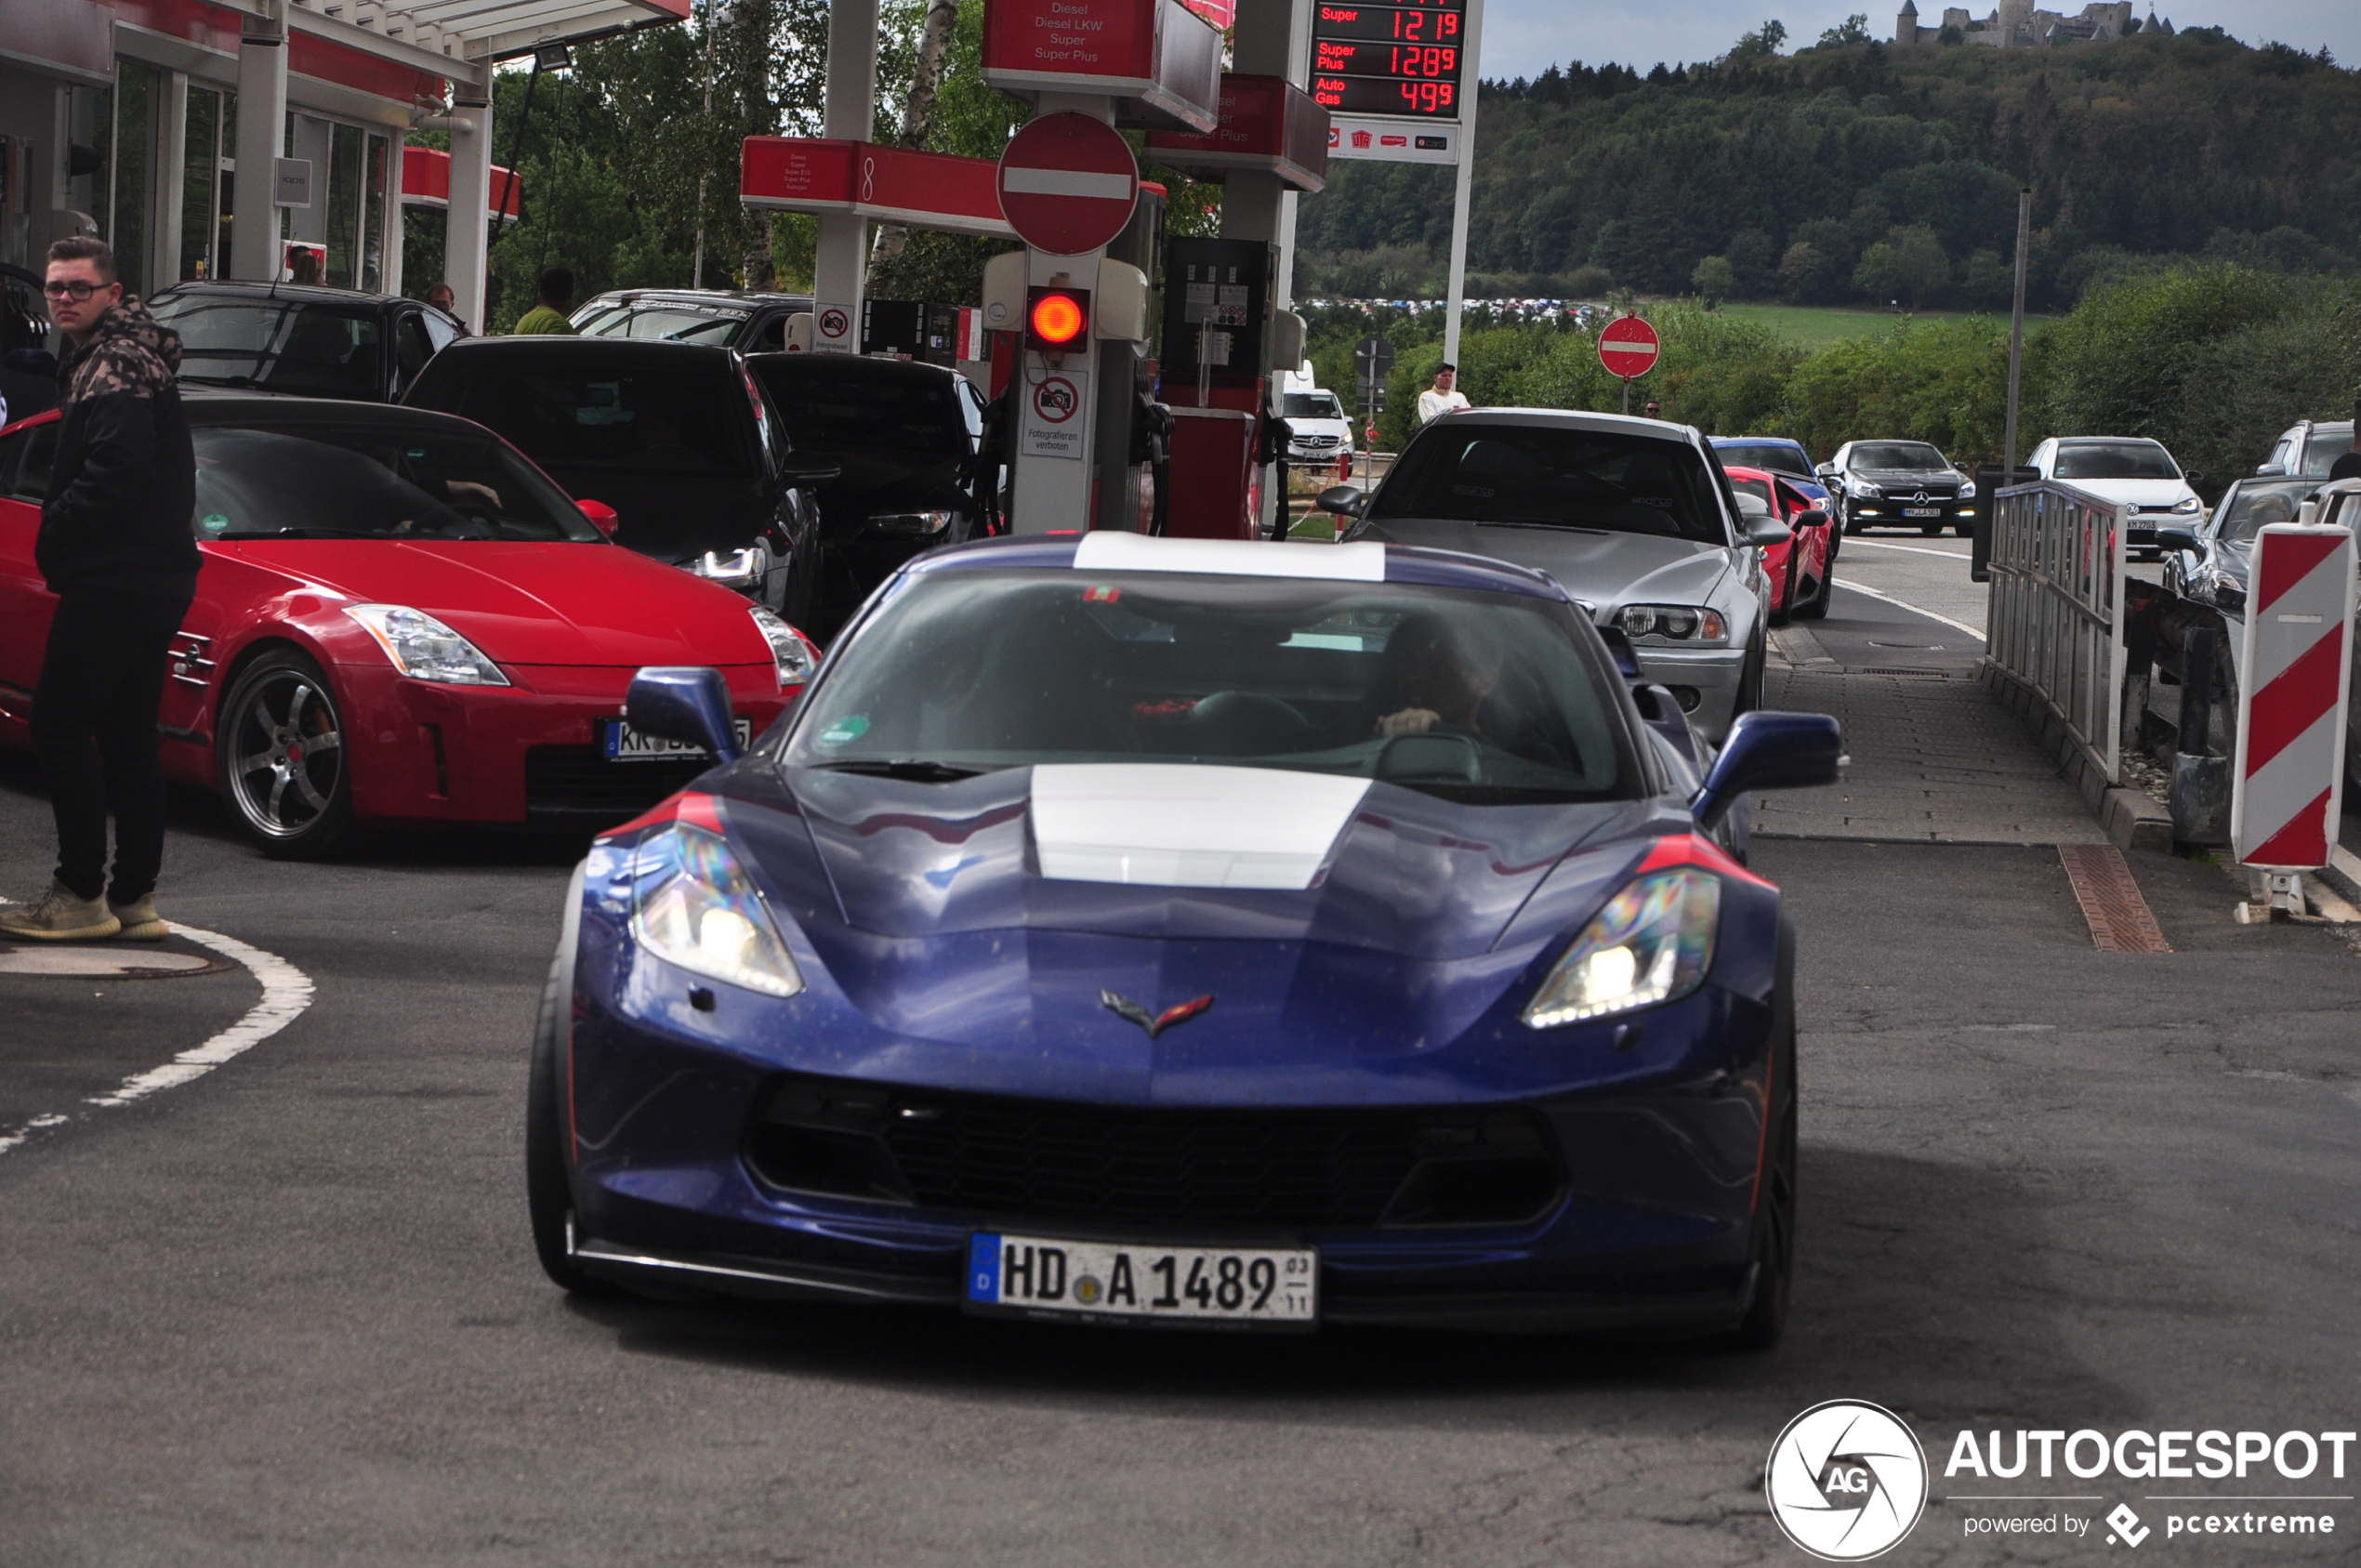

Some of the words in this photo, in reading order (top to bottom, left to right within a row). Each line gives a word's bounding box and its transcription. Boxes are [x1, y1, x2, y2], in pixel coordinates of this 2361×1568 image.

[1051, 2, 1088, 15] Diesel
[1035, 16, 1071, 29] Diesel
[1075, 20, 1102, 32] LKW
[1321, 7, 1358, 22] Super
[1393, 11, 1457, 41] 1219
[1050, 33, 1086, 46] Super
[1035, 47, 1070, 61] Super
[1073, 49, 1099, 62] Plus
[1318, 42, 1356, 58] Super
[1391, 46, 1456, 77] 1289
[1317, 57, 1344, 70] Plus
[1315, 91, 1340, 105] Gas
[1316, 77, 1346, 91] Auto
[1401, 83, 1453, 112] 499
[1220, 129, 1248, 142] Plus
[1426, 138, 1445, 148] card
[785, 168, 799, 177] Super
[863, 157, 874, 201] 8
[784, 176, 798, 184] Super
[1028, 428, 1077, 441] Fotografieren
[1036, 441, 1068, 451] verboten
[977, 1274, 990, 1291] D
[1003, 1244, 1067, 1300] HD
[1107, 1253, 1136, 1307] A
[1152, 1255, 1277, 1311] 1489
